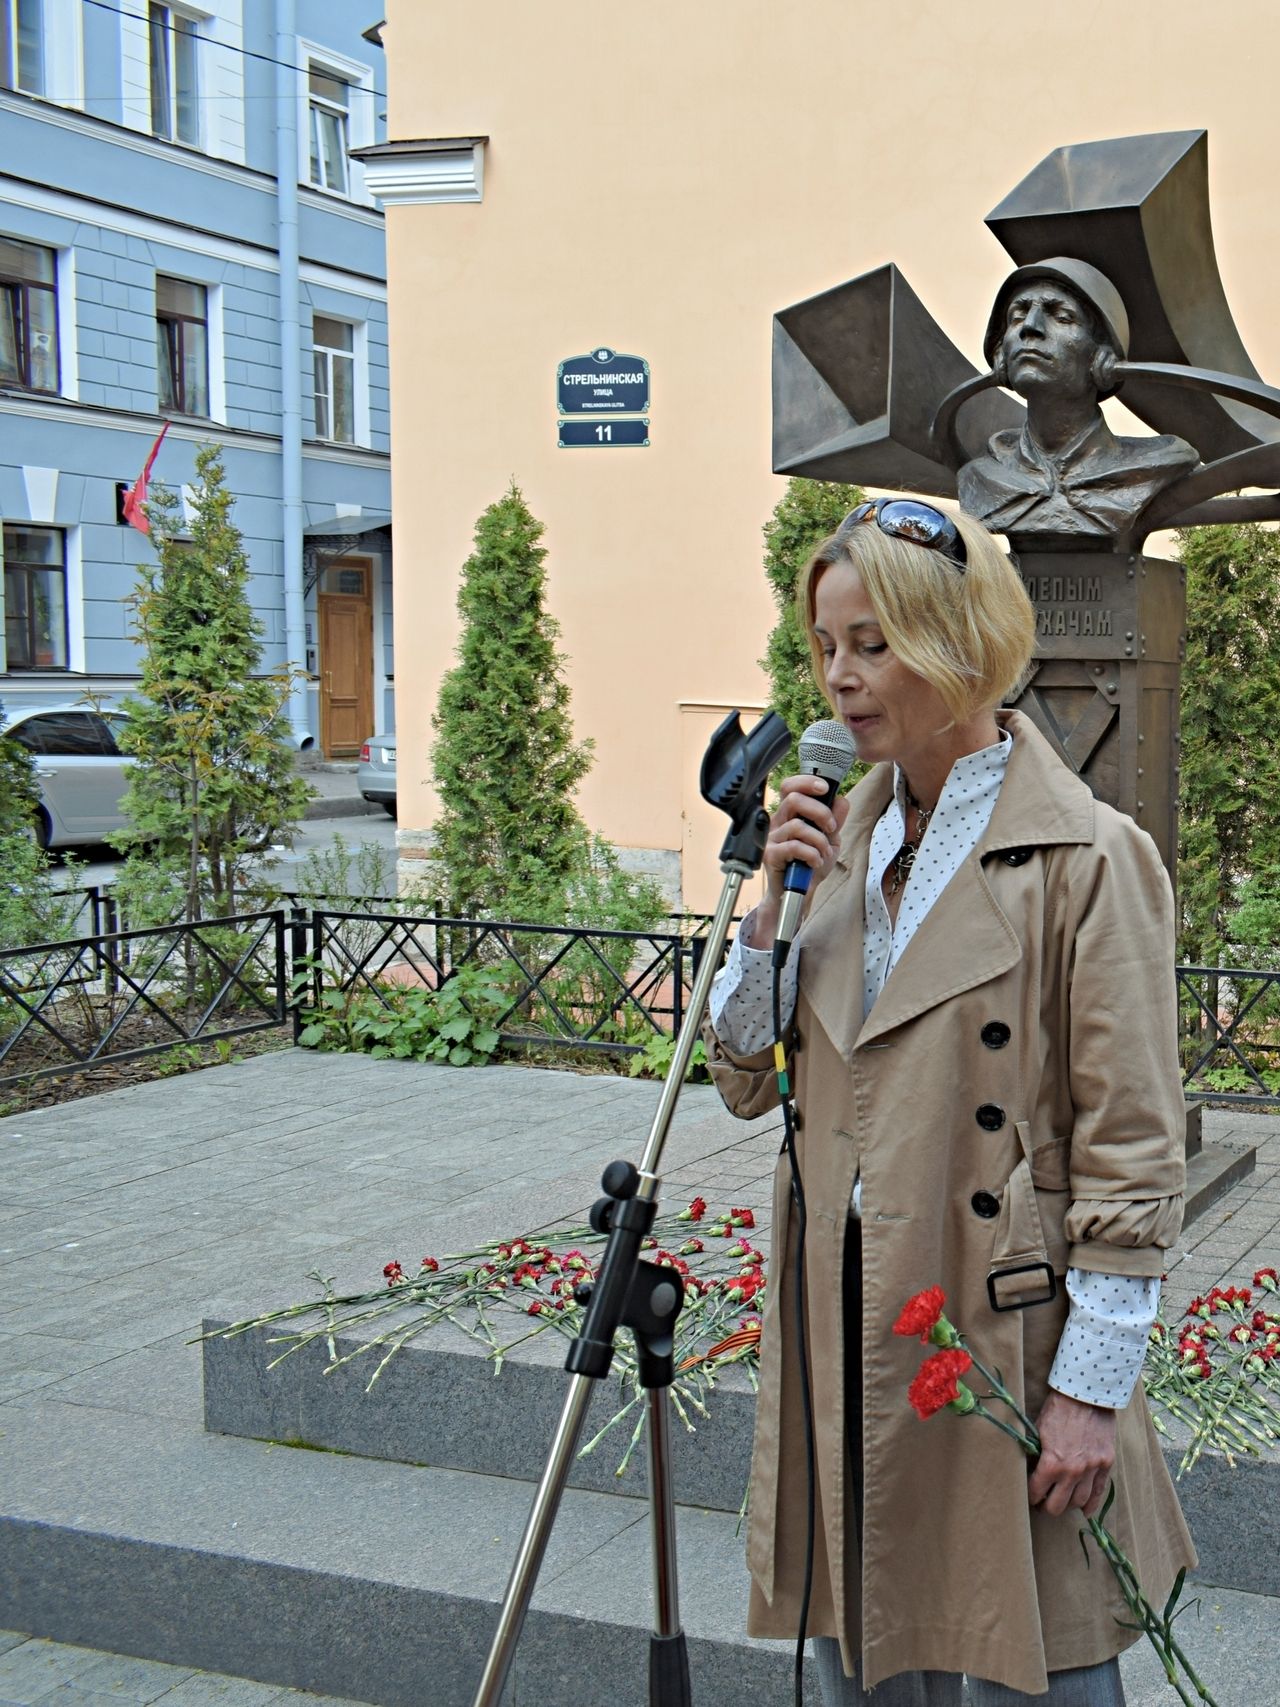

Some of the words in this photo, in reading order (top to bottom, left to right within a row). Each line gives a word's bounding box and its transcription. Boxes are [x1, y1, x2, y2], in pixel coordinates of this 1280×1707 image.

[563, 373, 644, 385] СТРЕЛЬНИНСКАЯ
[593, 388, 614, 397] УЛИЦА
[595, 425, 612, 441] 11
[1024, 576, 1104, 602] ЛЕПЫМ
[1036, 610, 1113, 637] ХАЧАМ
